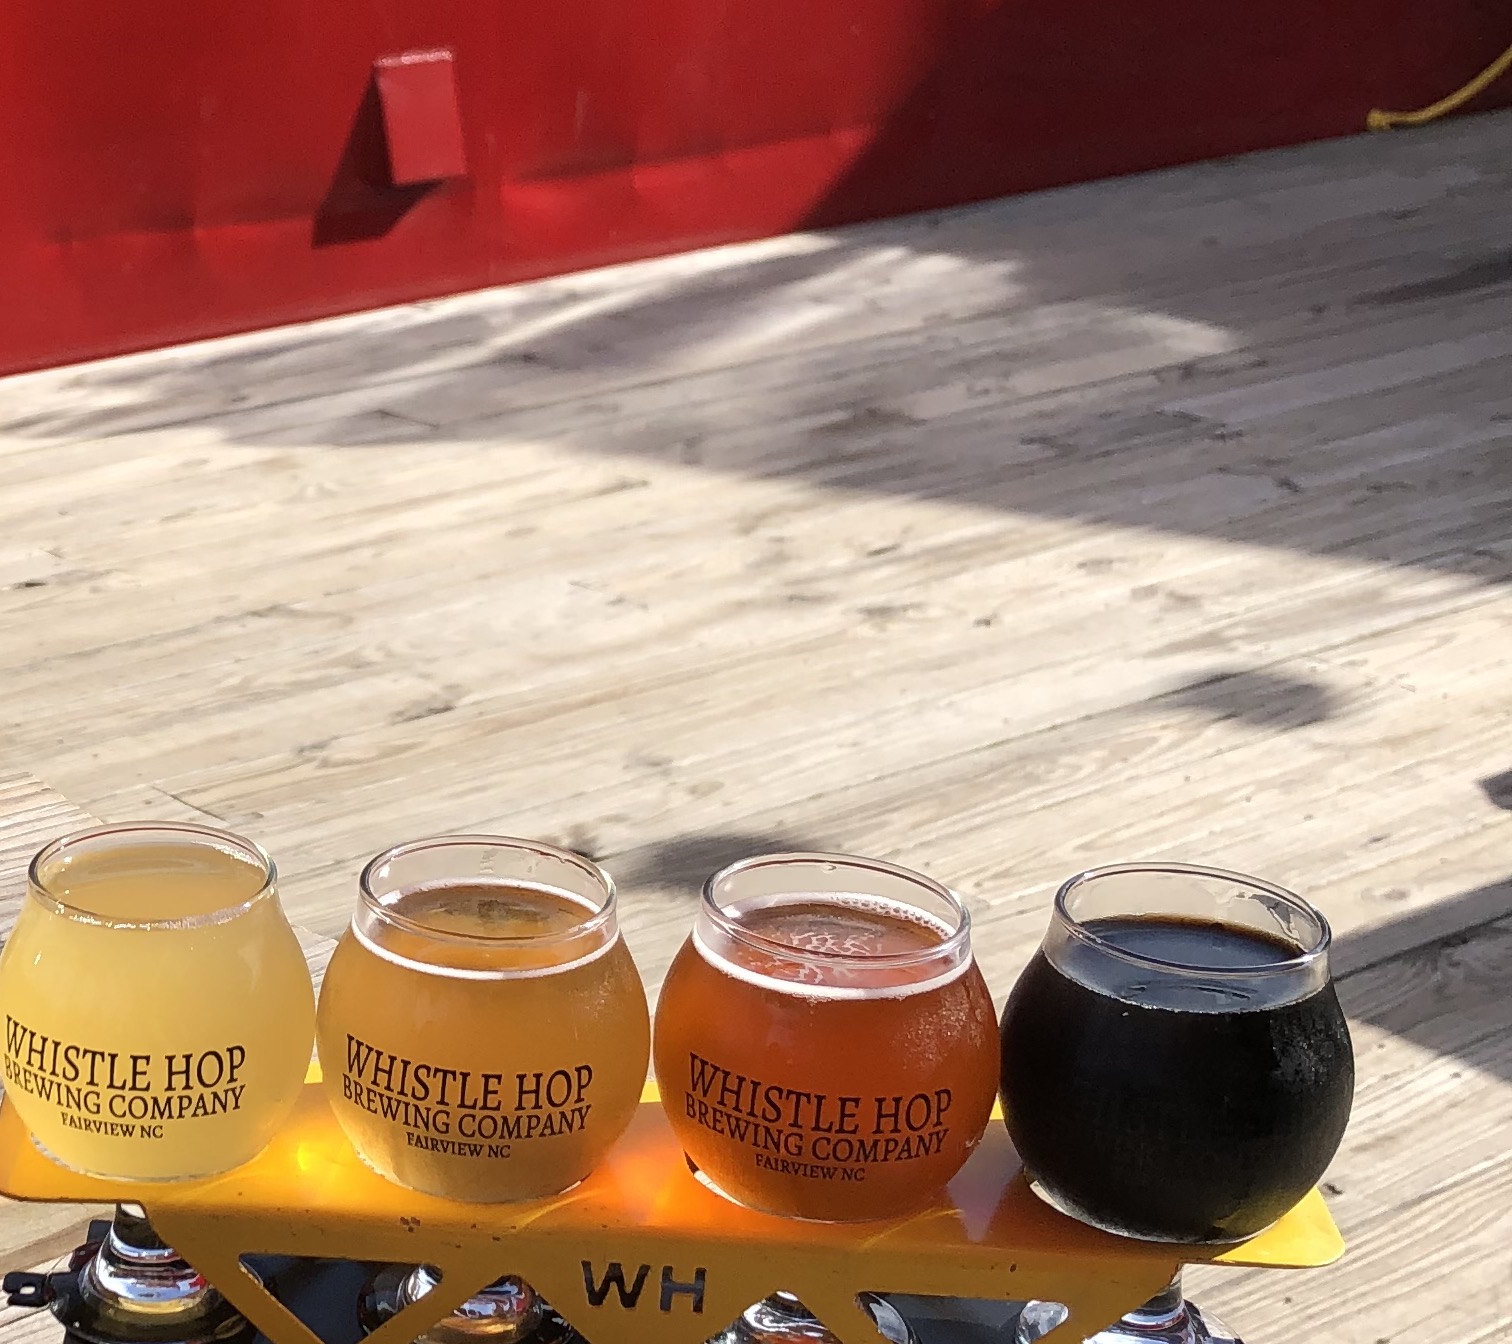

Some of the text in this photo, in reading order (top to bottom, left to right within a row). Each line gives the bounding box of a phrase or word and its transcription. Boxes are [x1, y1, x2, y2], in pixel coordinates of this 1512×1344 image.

[4, 1053, 246, 1120] BREWING COMPANY
[5, 1014, 246, 1092] WHISTLE HOP
[346, 1033, 593, 1111] WHISTLE HOP
[60, 1111, 164, 1139] FAIRVIEW NC
[342, 1073, 592, 1140] BREWING COMPANY
[689, 1051, 952, 1135] WHISTLE HOP
[406, 1131, 511, 1158] FAIRVIEW NC
[684, 1091, 949, 1164] BREWING COMPANY
[755, 1153, 866, 1182] FAIRVIEW NC
[581, 1260, 707, 1314] WH
